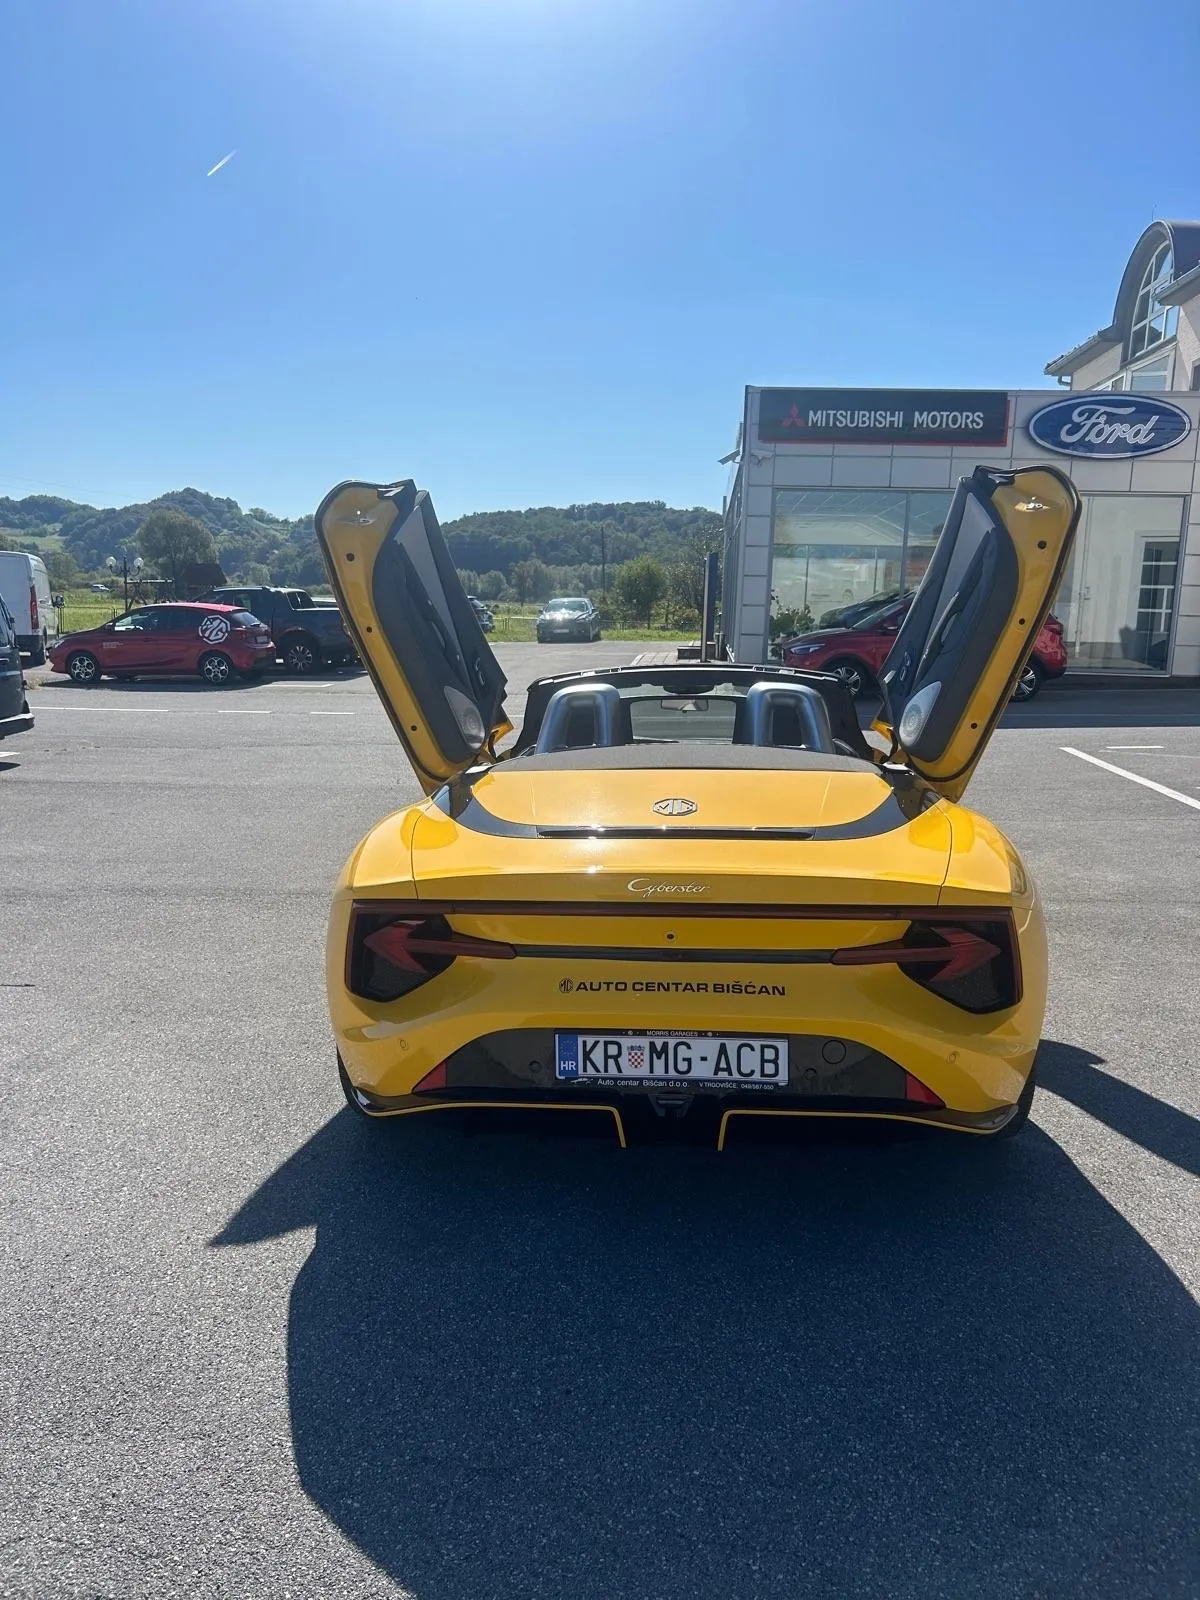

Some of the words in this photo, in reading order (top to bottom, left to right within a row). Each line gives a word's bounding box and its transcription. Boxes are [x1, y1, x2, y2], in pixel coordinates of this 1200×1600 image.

[808, 410, 904, 428] MITSUBISHI
[913, 411, 985, 429] MOTORS
[1059, 405, 1160, 446] Ford
[627, 878, 710, 898] Cyberster
[575, 981, 628, 992] AUTO
[632, 981, 709, 993] CENTAR
[712, 980, 786, 996] BIŠĆAN
[560, 1060, 576, 1071] HR
[582, 1039, 623, 1073] KR
